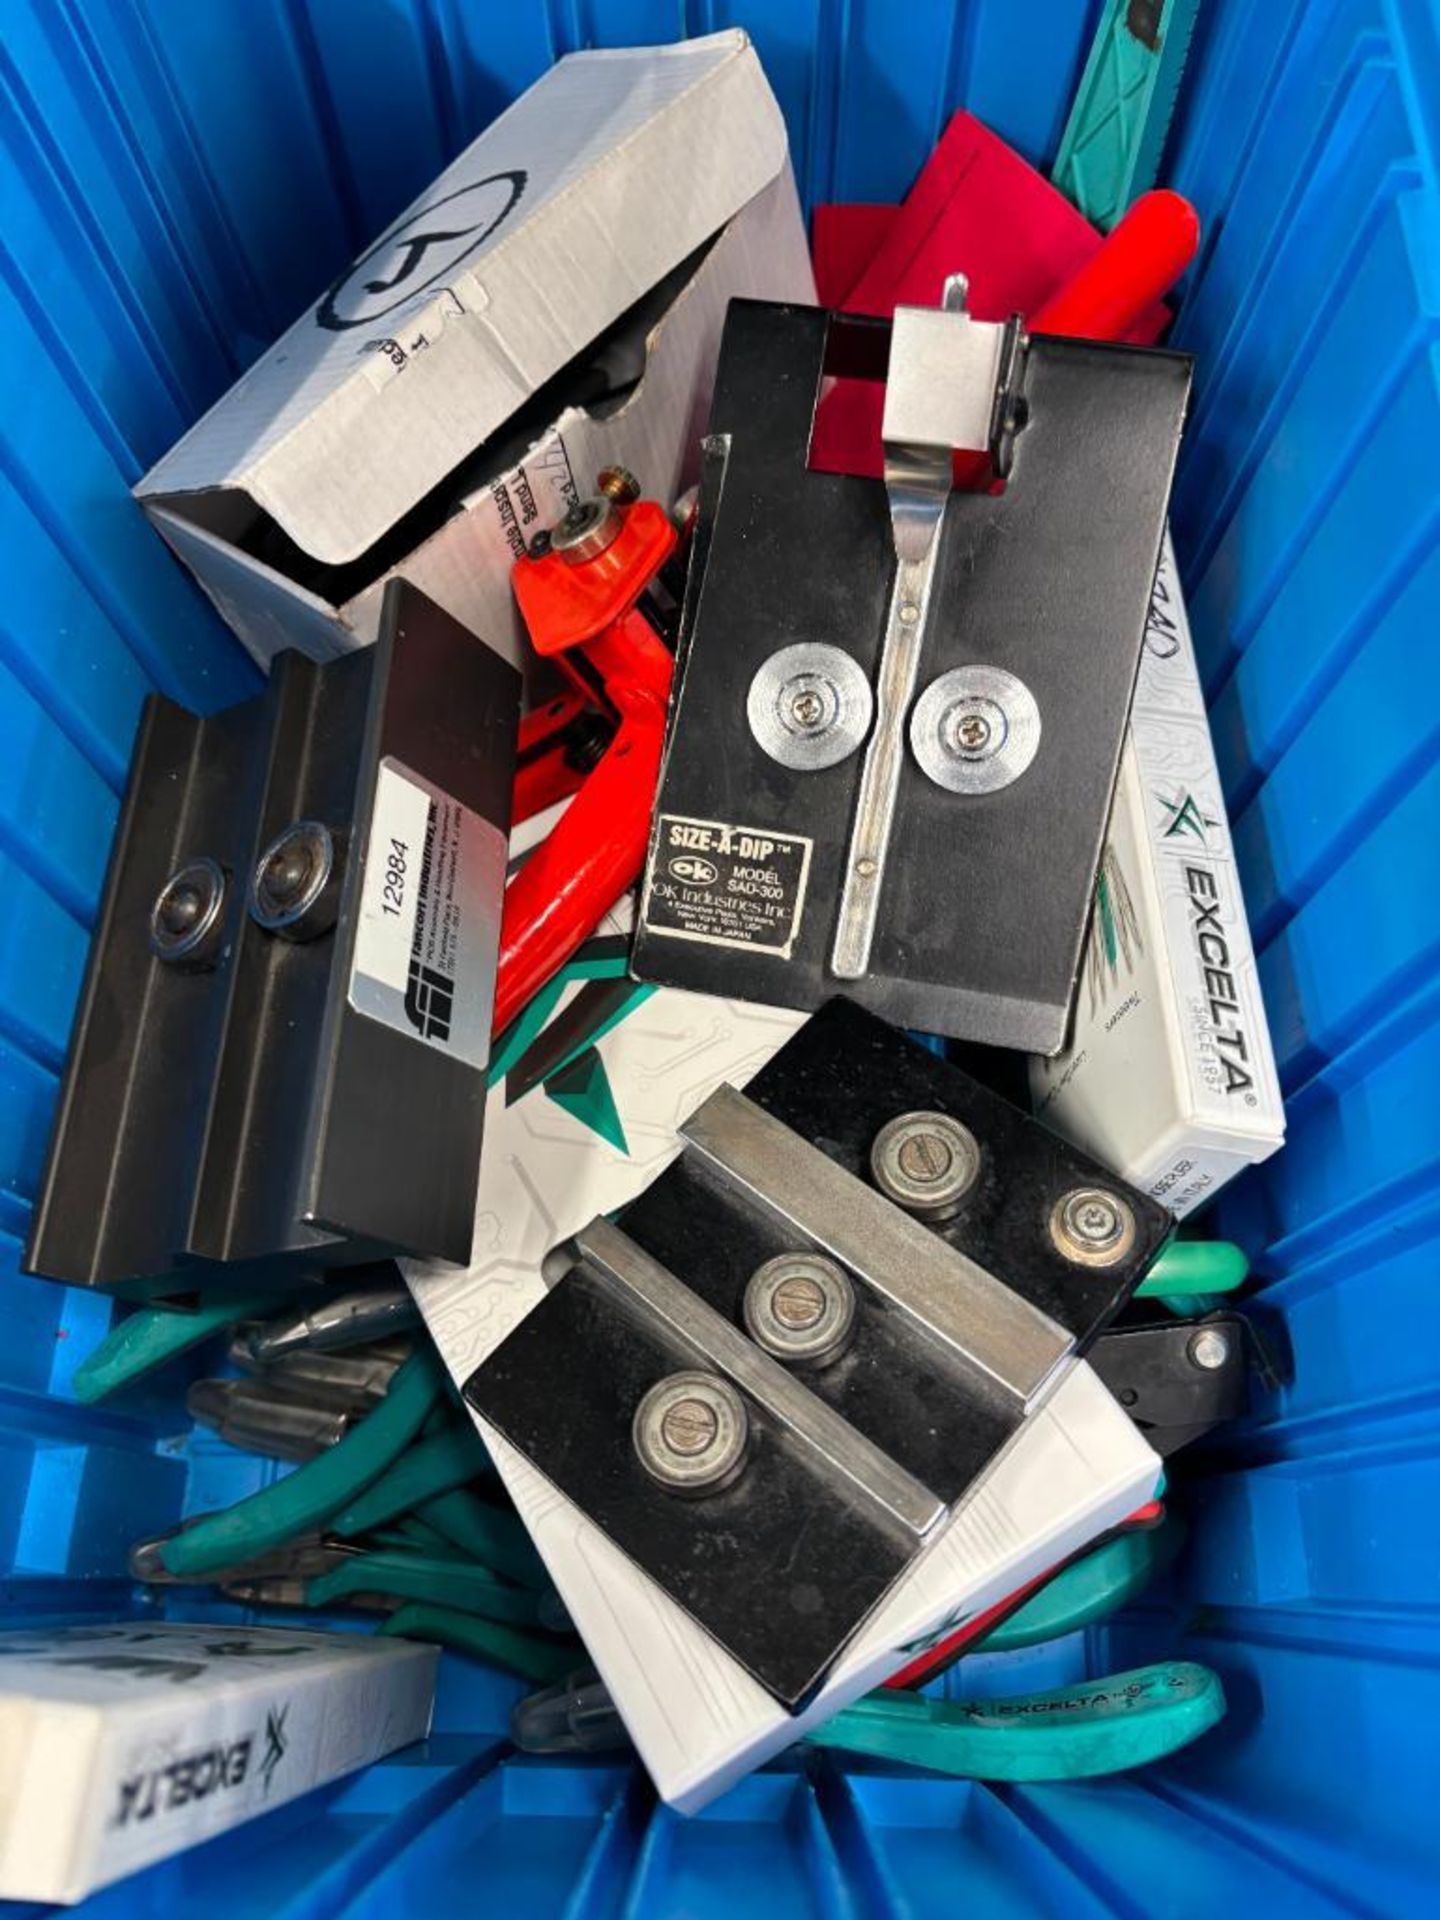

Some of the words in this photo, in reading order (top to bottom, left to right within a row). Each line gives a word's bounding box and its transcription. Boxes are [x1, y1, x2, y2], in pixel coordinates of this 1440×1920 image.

[514, 483, 539, 525] Send
[669, 824, 775, 861] SIZE-A-DIP
[382, 837, 409, 918] 12984
[727, 878, 784, 900] SAD-300
[733, 865, 781, 886] MODEL
[682, 887, 762, 914] Industries
[684, 920, 710, 933] MADE
[722, 929, 752, 941] JAPAN
[1185, 865, 1254, 1096] EXCELTA
